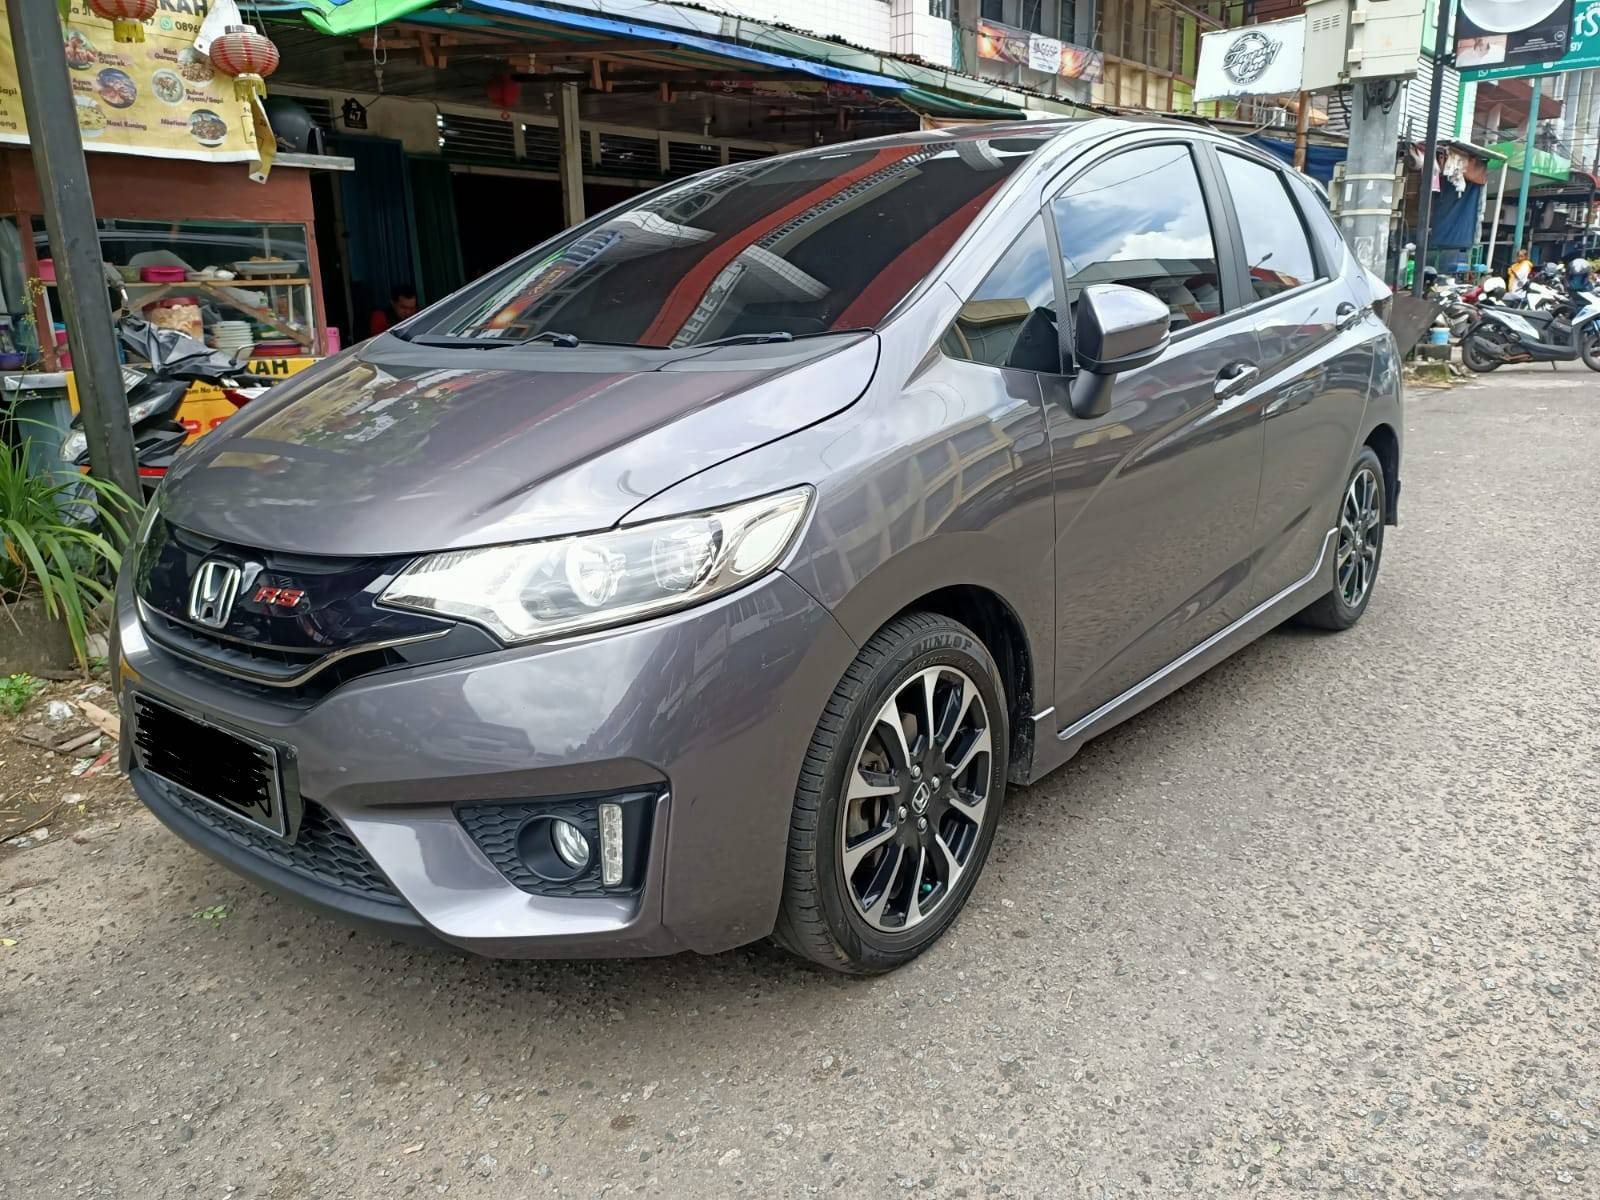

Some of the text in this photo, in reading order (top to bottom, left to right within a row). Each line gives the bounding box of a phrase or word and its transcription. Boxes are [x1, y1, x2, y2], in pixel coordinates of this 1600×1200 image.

[248, 359, 289, 375] AH
[253, 586, 305, 608] RS
[911, 634, 973, 658] DUNLOP
